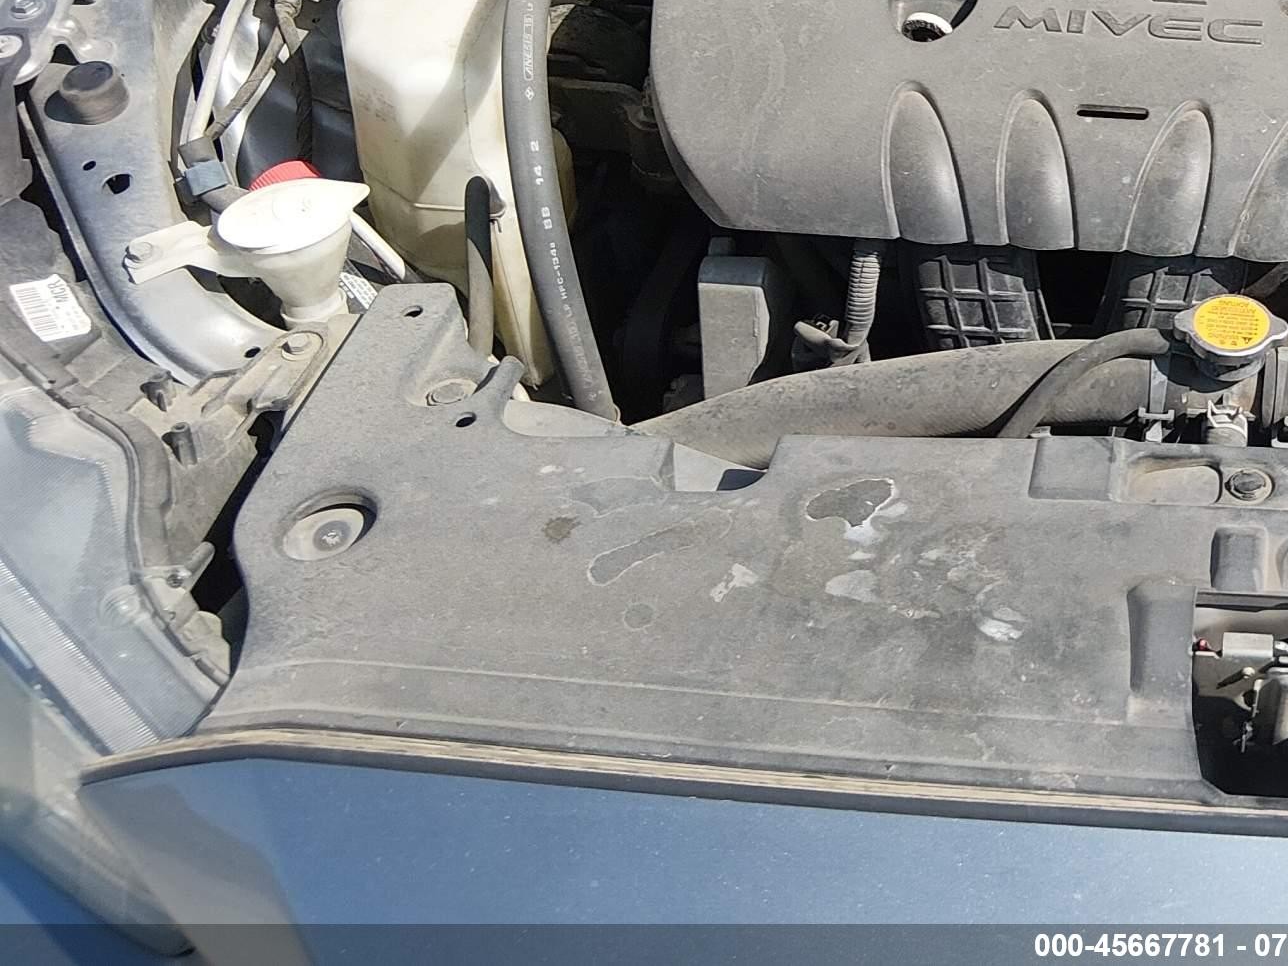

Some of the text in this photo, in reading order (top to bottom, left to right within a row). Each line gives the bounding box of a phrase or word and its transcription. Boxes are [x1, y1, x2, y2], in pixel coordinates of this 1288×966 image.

[993, 5, 1264, 45] MIVEC
[530, 139, 540, 152] 2
[533, 164, 545, 186] 14
